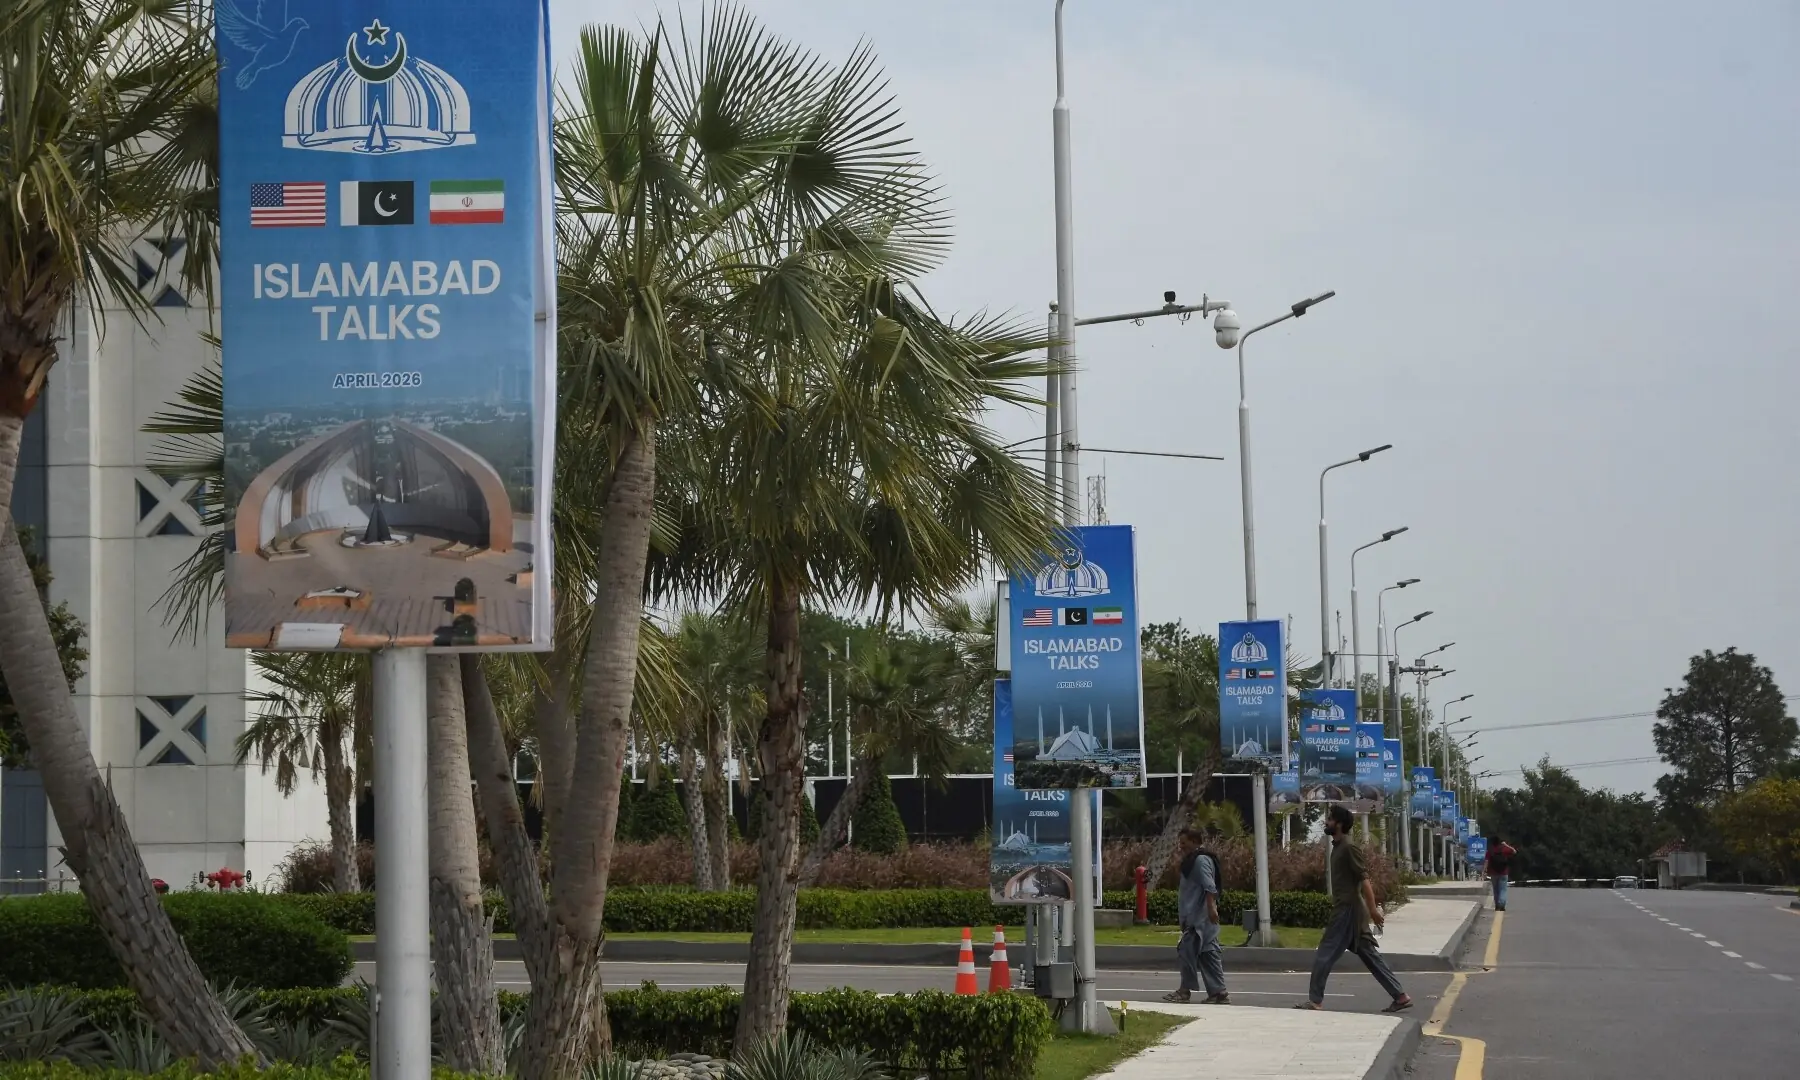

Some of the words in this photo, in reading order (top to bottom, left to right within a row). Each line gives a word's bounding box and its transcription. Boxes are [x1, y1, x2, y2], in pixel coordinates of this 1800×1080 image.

[253, 259, 501, 299] ISLAMABAD
[311, 304, 441, 341] TALKS
[333, 373, 379, 389] APRIL
[381, 371, 422, 388] 2026
[1024, 637, 1123, 654] ISLAMABAD
[1047, 654, 1099, 670] TALKS
[1056, 681, 1075, 689] APRIL
[1225, 685, 1274, 696] ISLAMABAD
[1237, 695, 1263, 705] TALKS
[1305, 737, 1350, 745] ISLAMABAD
[1315, 744, 1340, 752] TALKS
[1025, 790, 1065, 801] TALKS
